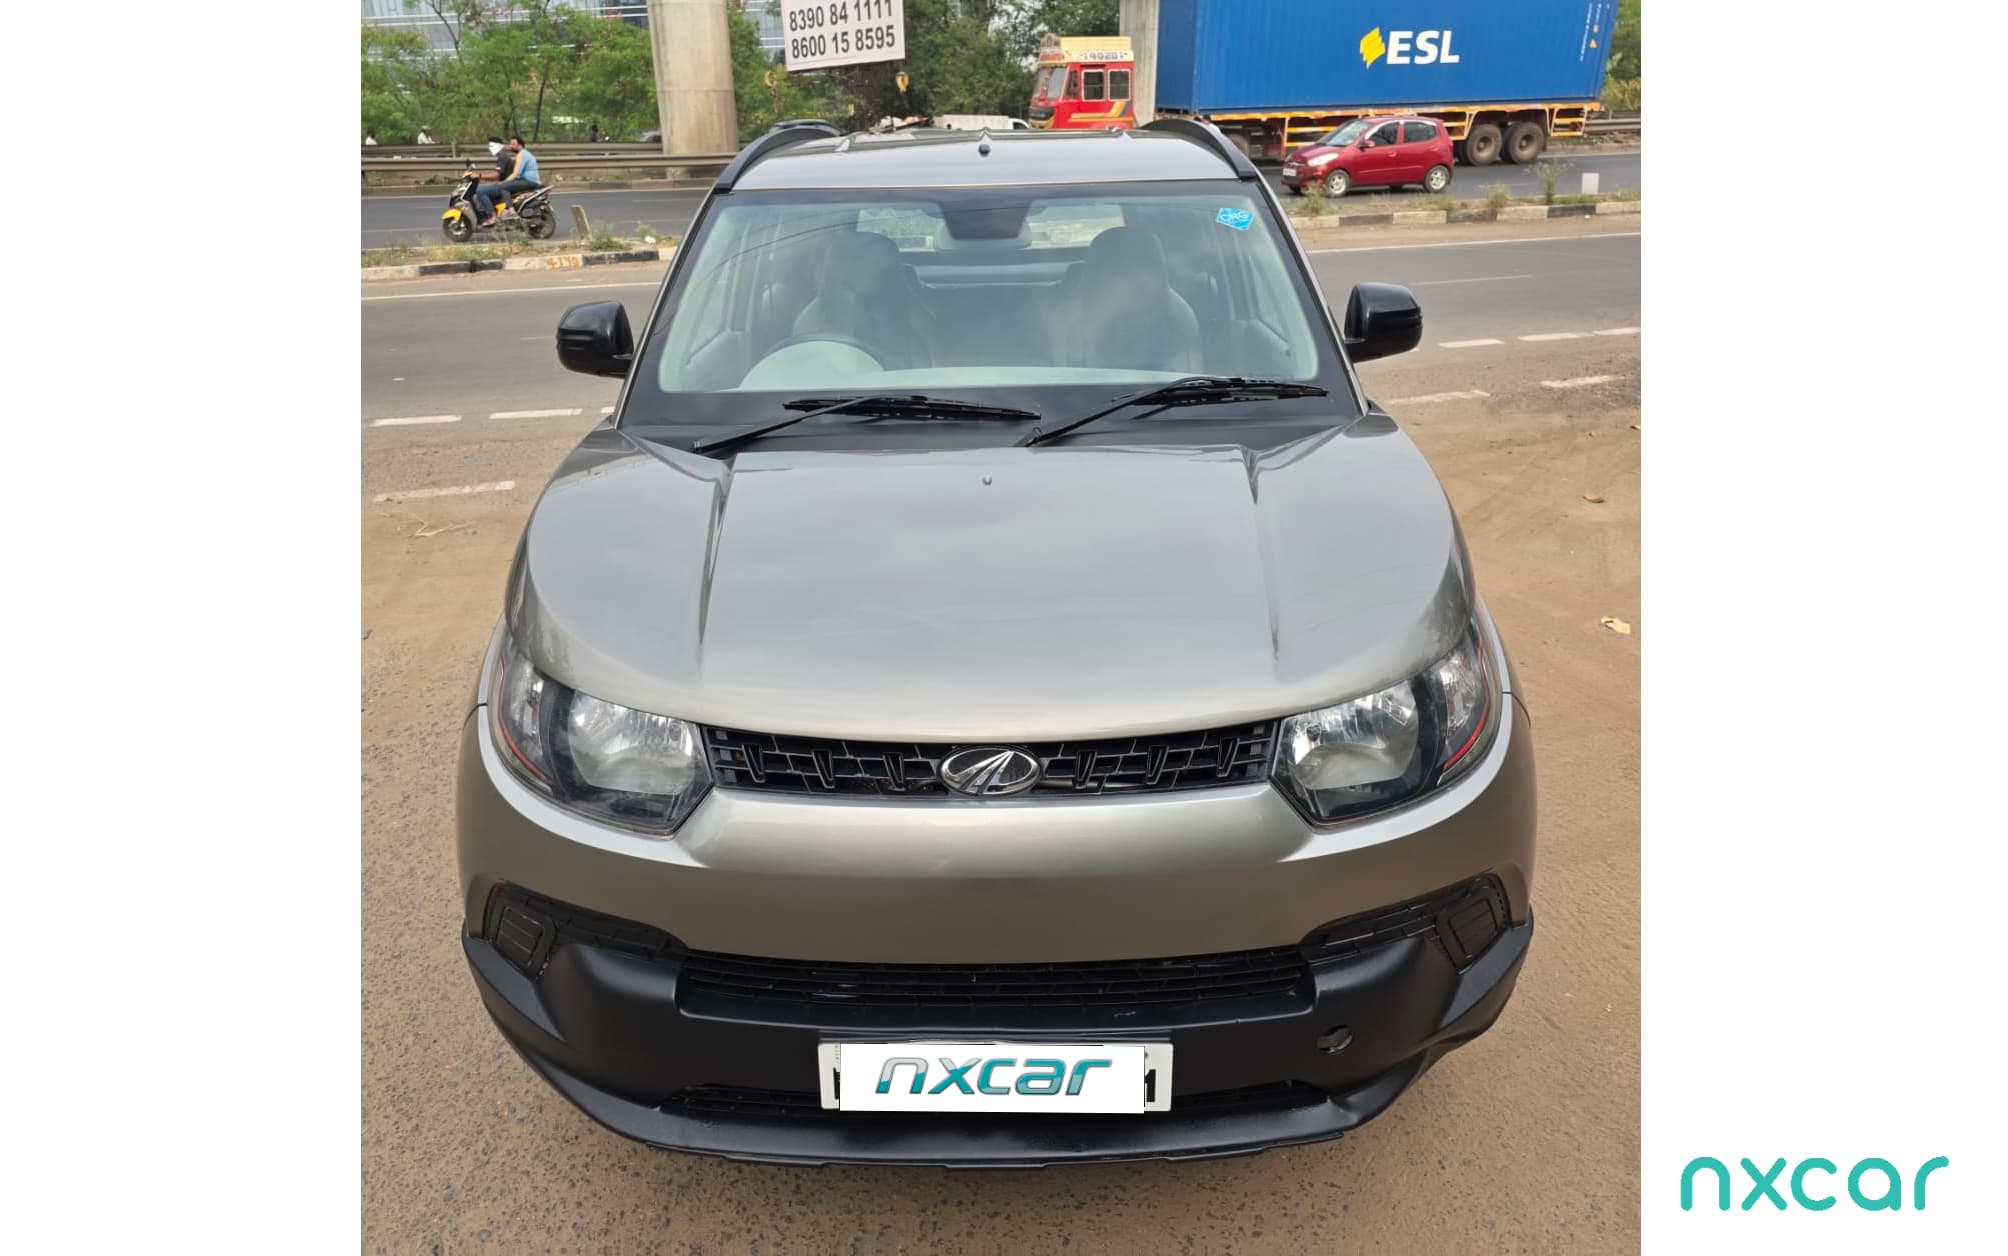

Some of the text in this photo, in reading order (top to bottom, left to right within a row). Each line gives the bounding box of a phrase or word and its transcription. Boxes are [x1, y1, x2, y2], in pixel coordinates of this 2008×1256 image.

[789, 0, 892, 31] 8390 84 1111
[791, 24, 895, 59] 8600 15 8595
[1386, 30, 1460, 65] ESL
